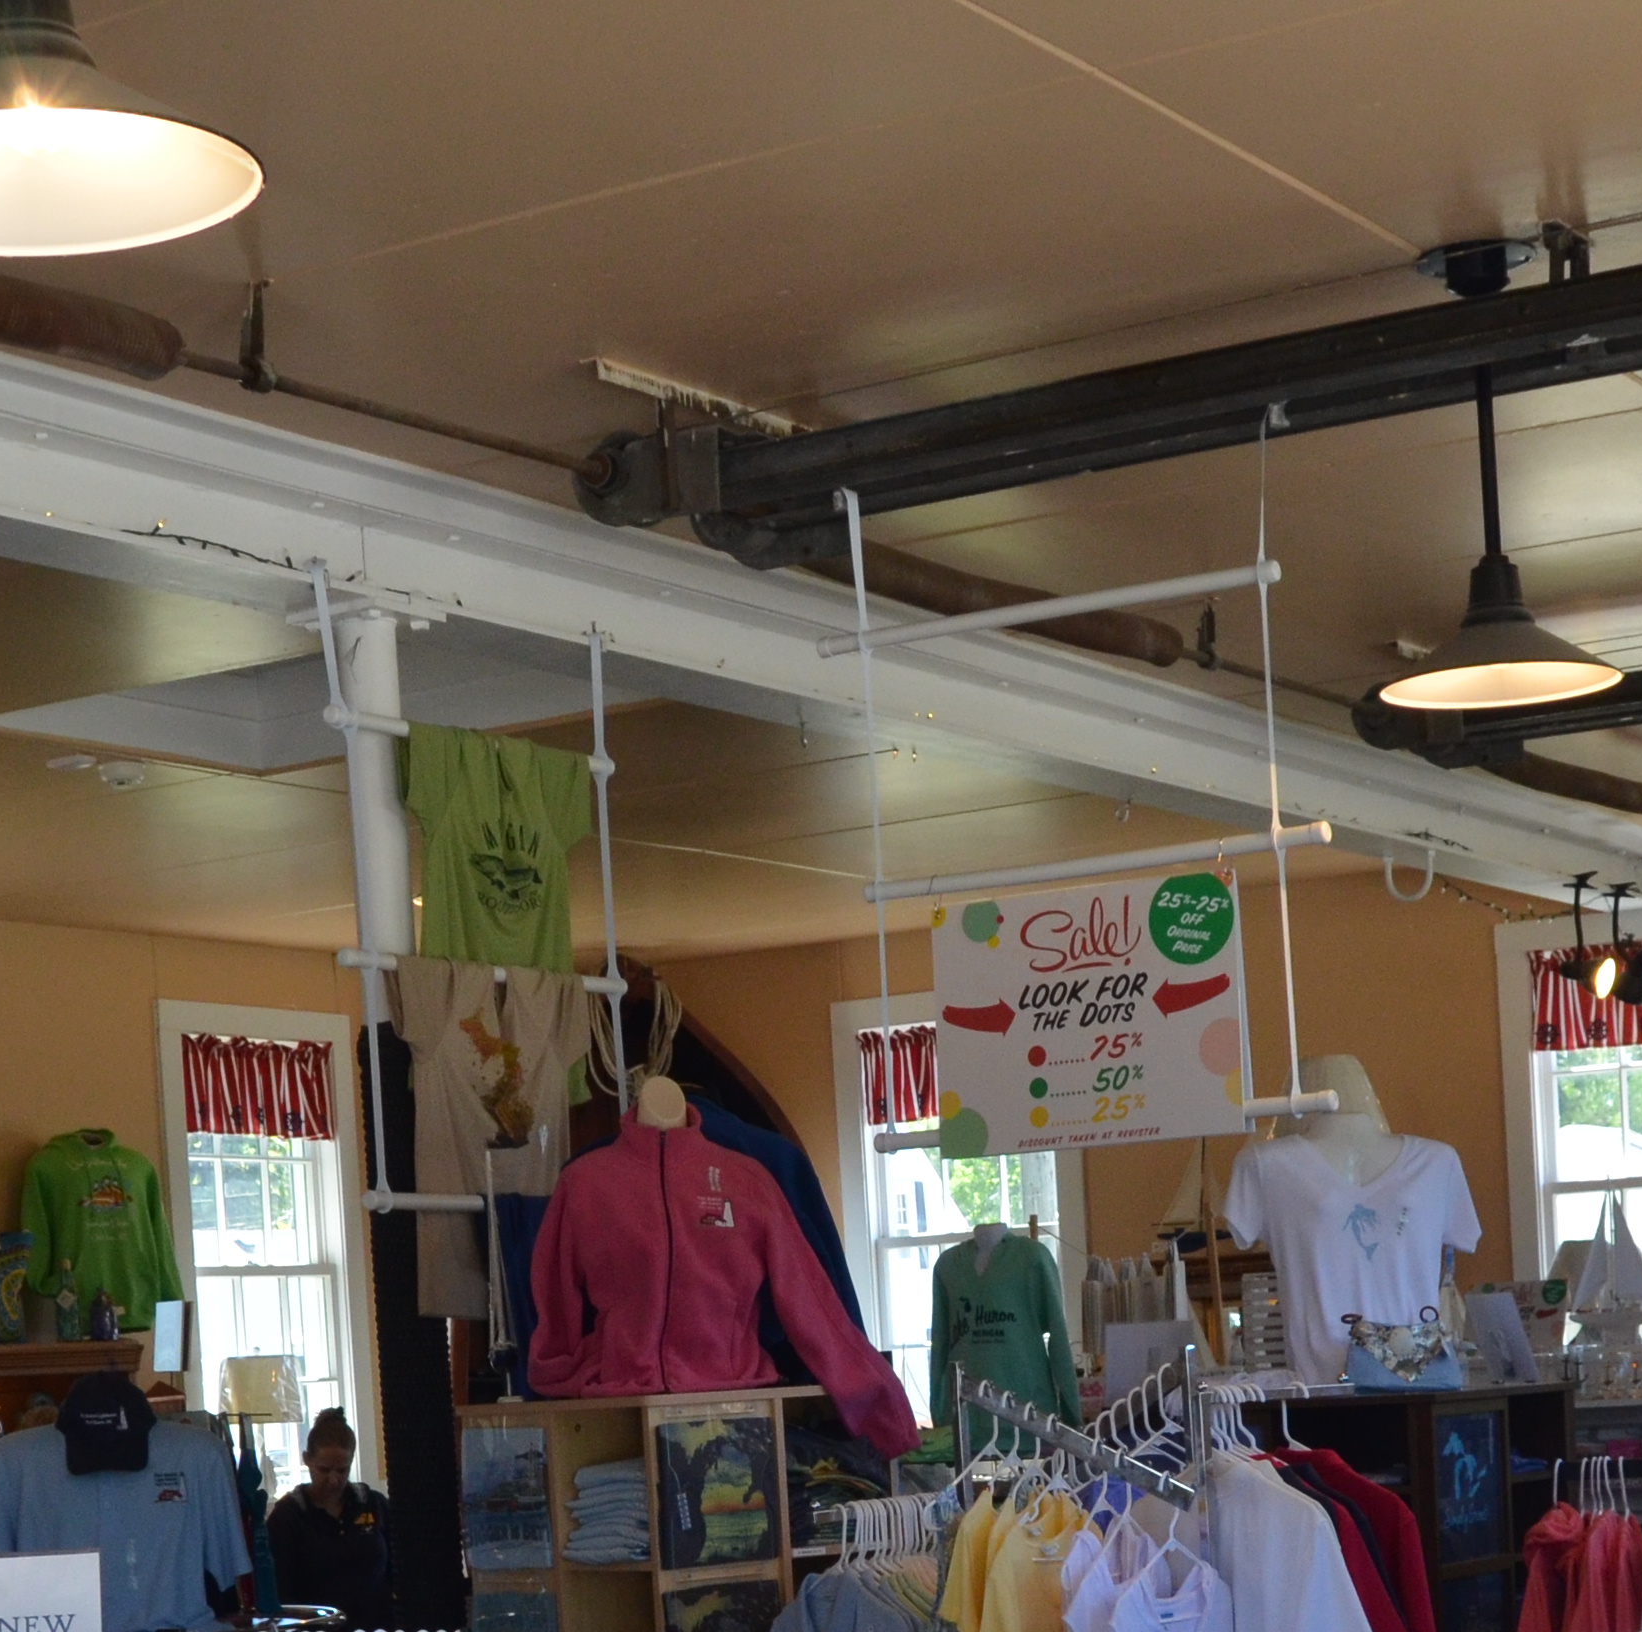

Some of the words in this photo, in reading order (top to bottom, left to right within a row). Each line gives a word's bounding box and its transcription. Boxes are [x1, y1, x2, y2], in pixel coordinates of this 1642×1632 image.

[1180, 912, 1205, 925] OFF
[1020, 895, 1142, 973] Sale!
[1018, 980, 1085, 1011] LOOK
[1096, 972, 1148, 1002] FOR
[1032, 1008, 1070, 1032] THE
[1079, 1002, 1135, 1028] DOTS
[1090, 1032, 1143, 1061] 75%
[1092, 1065, 1143, 1093] 50%
[1091, 1094, 1146, 1123] 25%
[1018, 1136, 1063, 1148] DISCOUNT
[1068, 1133, 1098, 1143] TAKEN
[1101, 1131, 1113, 1139] AT
[1117, 1127, 1160, 1138] REGISTER
